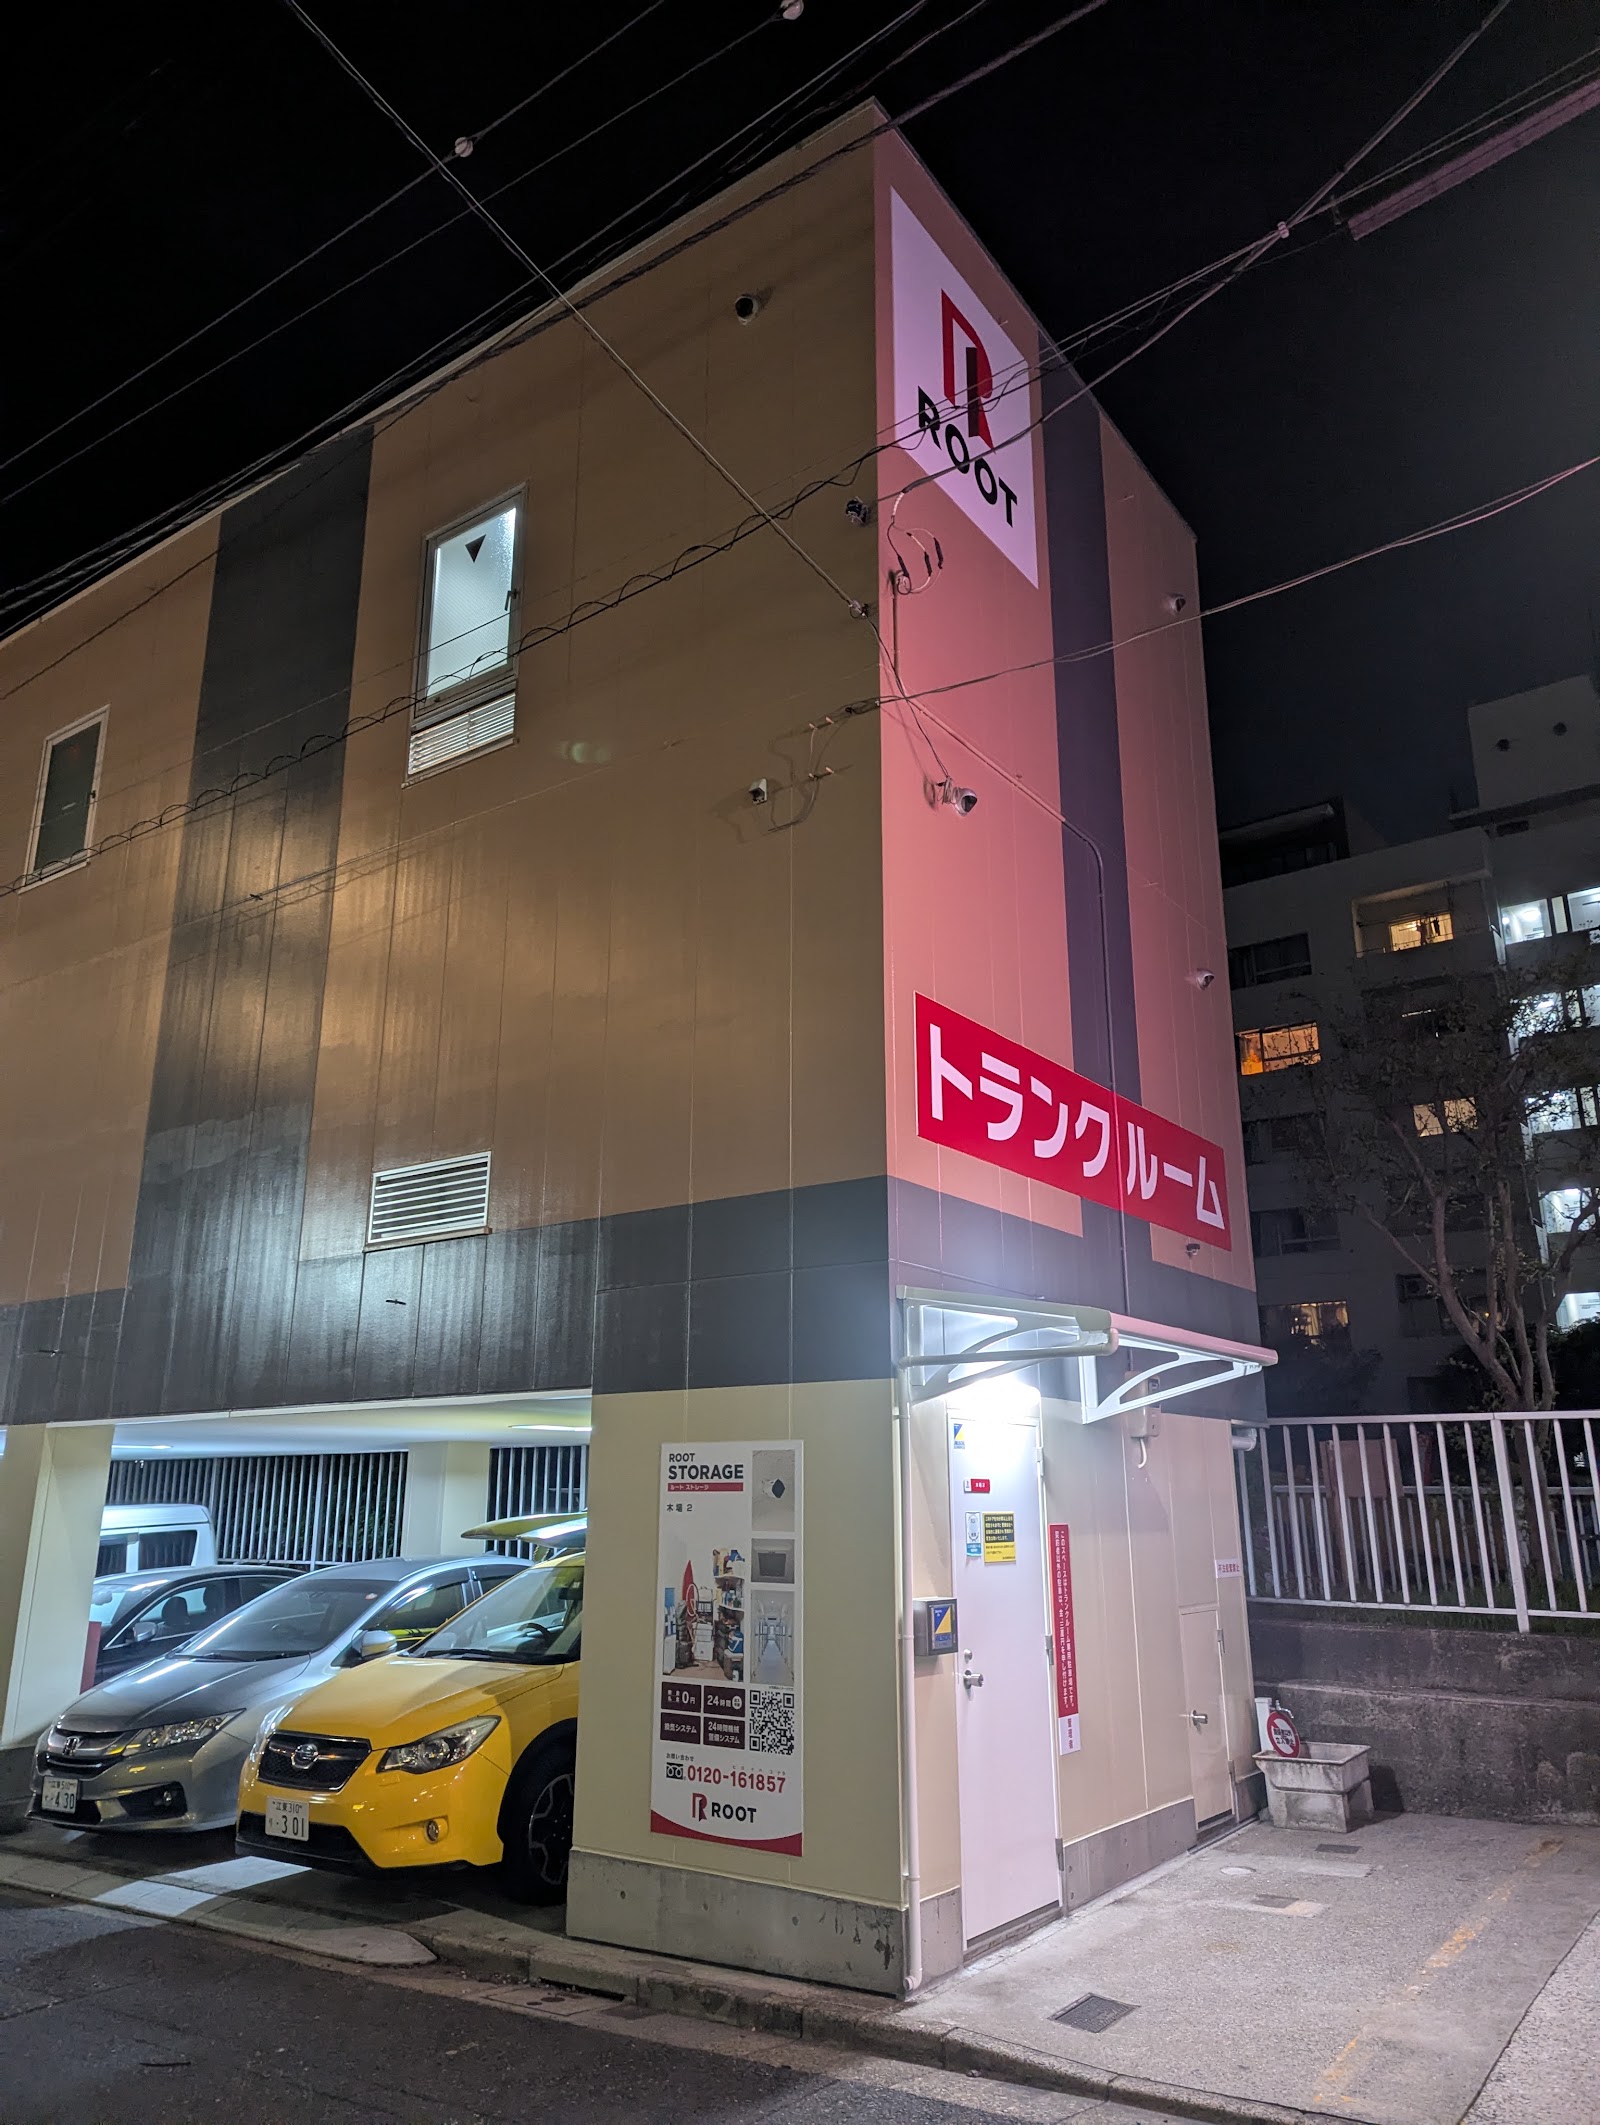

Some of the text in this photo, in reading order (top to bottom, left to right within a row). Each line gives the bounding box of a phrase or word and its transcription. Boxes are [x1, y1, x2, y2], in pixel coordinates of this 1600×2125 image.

[918, 385, 1018, 528] ROOT
[929, 1023, 1226, 1231] トランクルーム
[669, 1452, 696, 1463] ROOT
[668, 1464, 744, 1480] STORAGE
[686, 1503, 693, 1512] 2
[707, 1695, 731, 1707] 24時間
[666, 1752, 694, 1762] お問い合わせ
[687, 1764, 786, 1793] 0120-161857
[711, 1801, 757, 1823] ROOT
